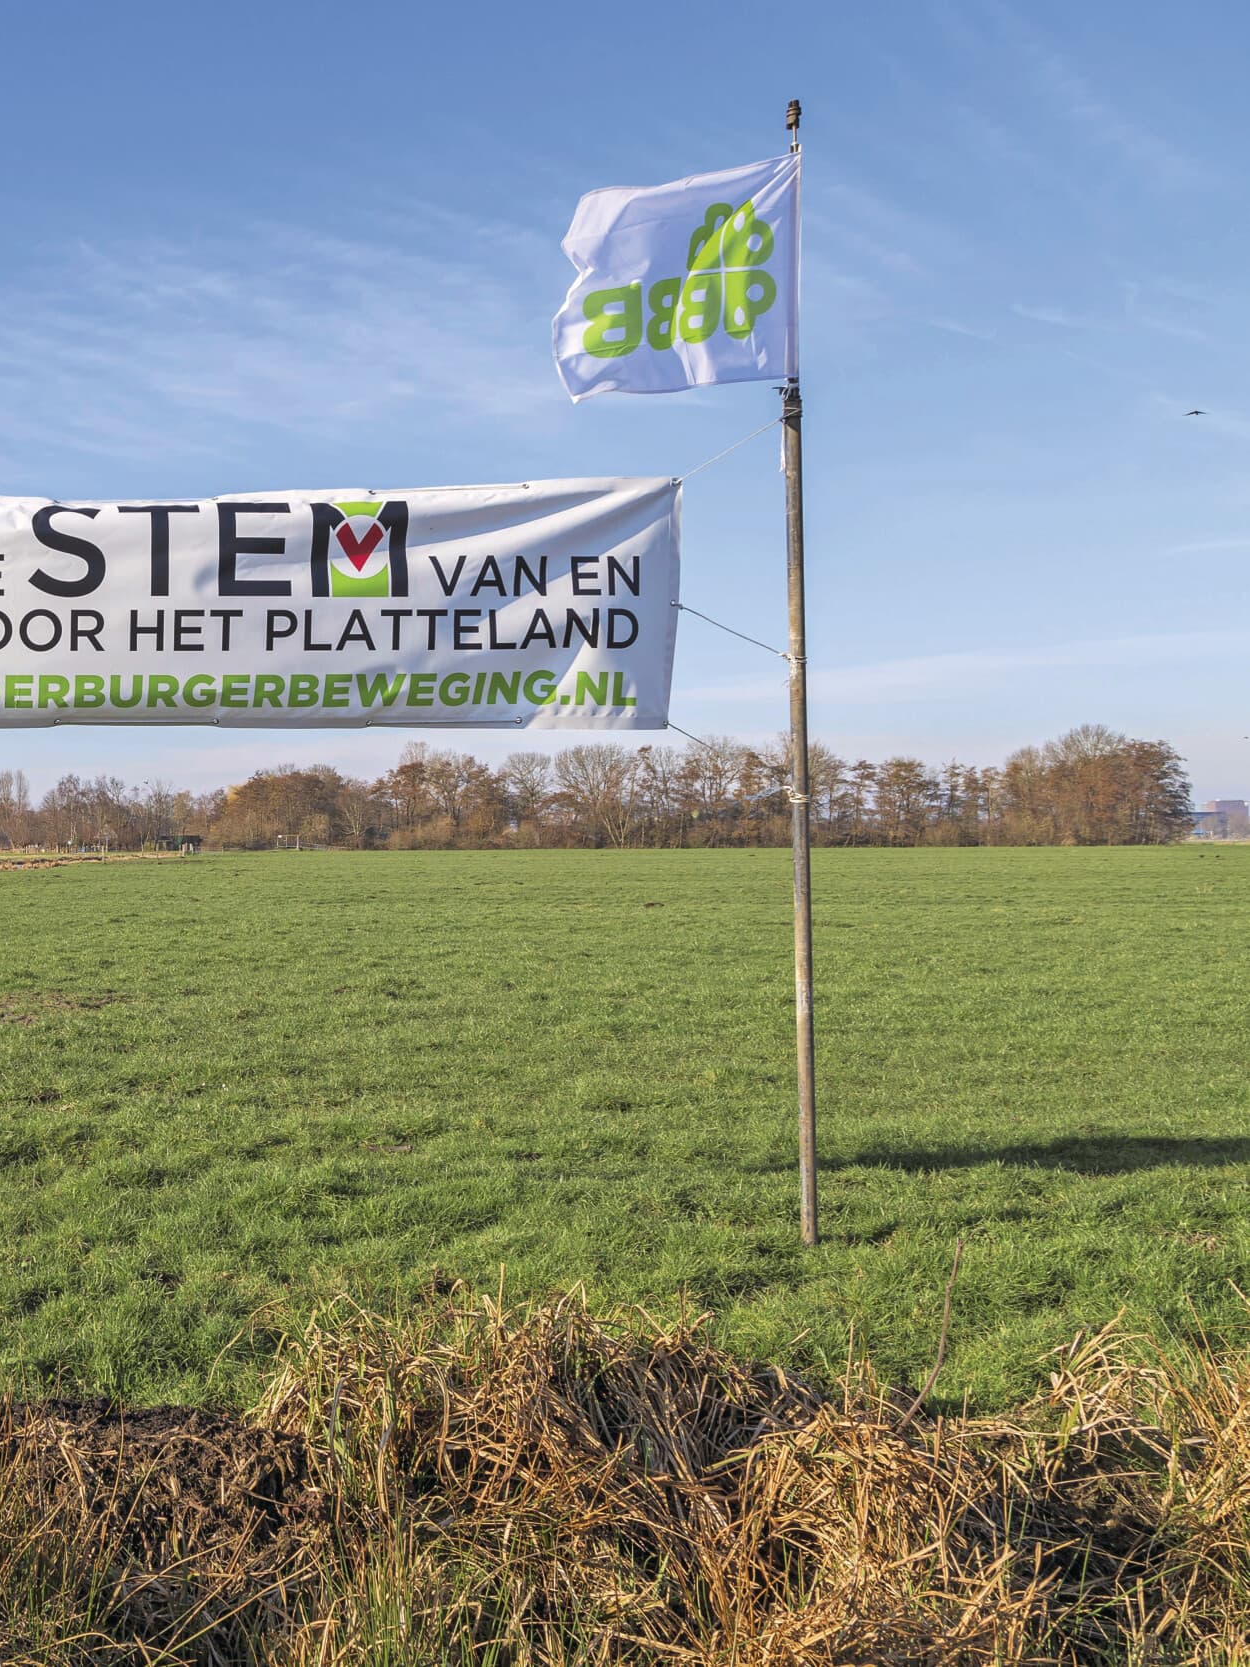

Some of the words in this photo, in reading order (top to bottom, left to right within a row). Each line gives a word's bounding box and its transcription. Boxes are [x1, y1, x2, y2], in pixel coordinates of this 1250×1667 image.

[28, 500, 409, 598] STEM
[428, 555, 548, 597] VAN
[570, 555, 641, 597] EN
[130, 609, 244, 651] HET
[266, 607, 640, 651] PLATTELAND
